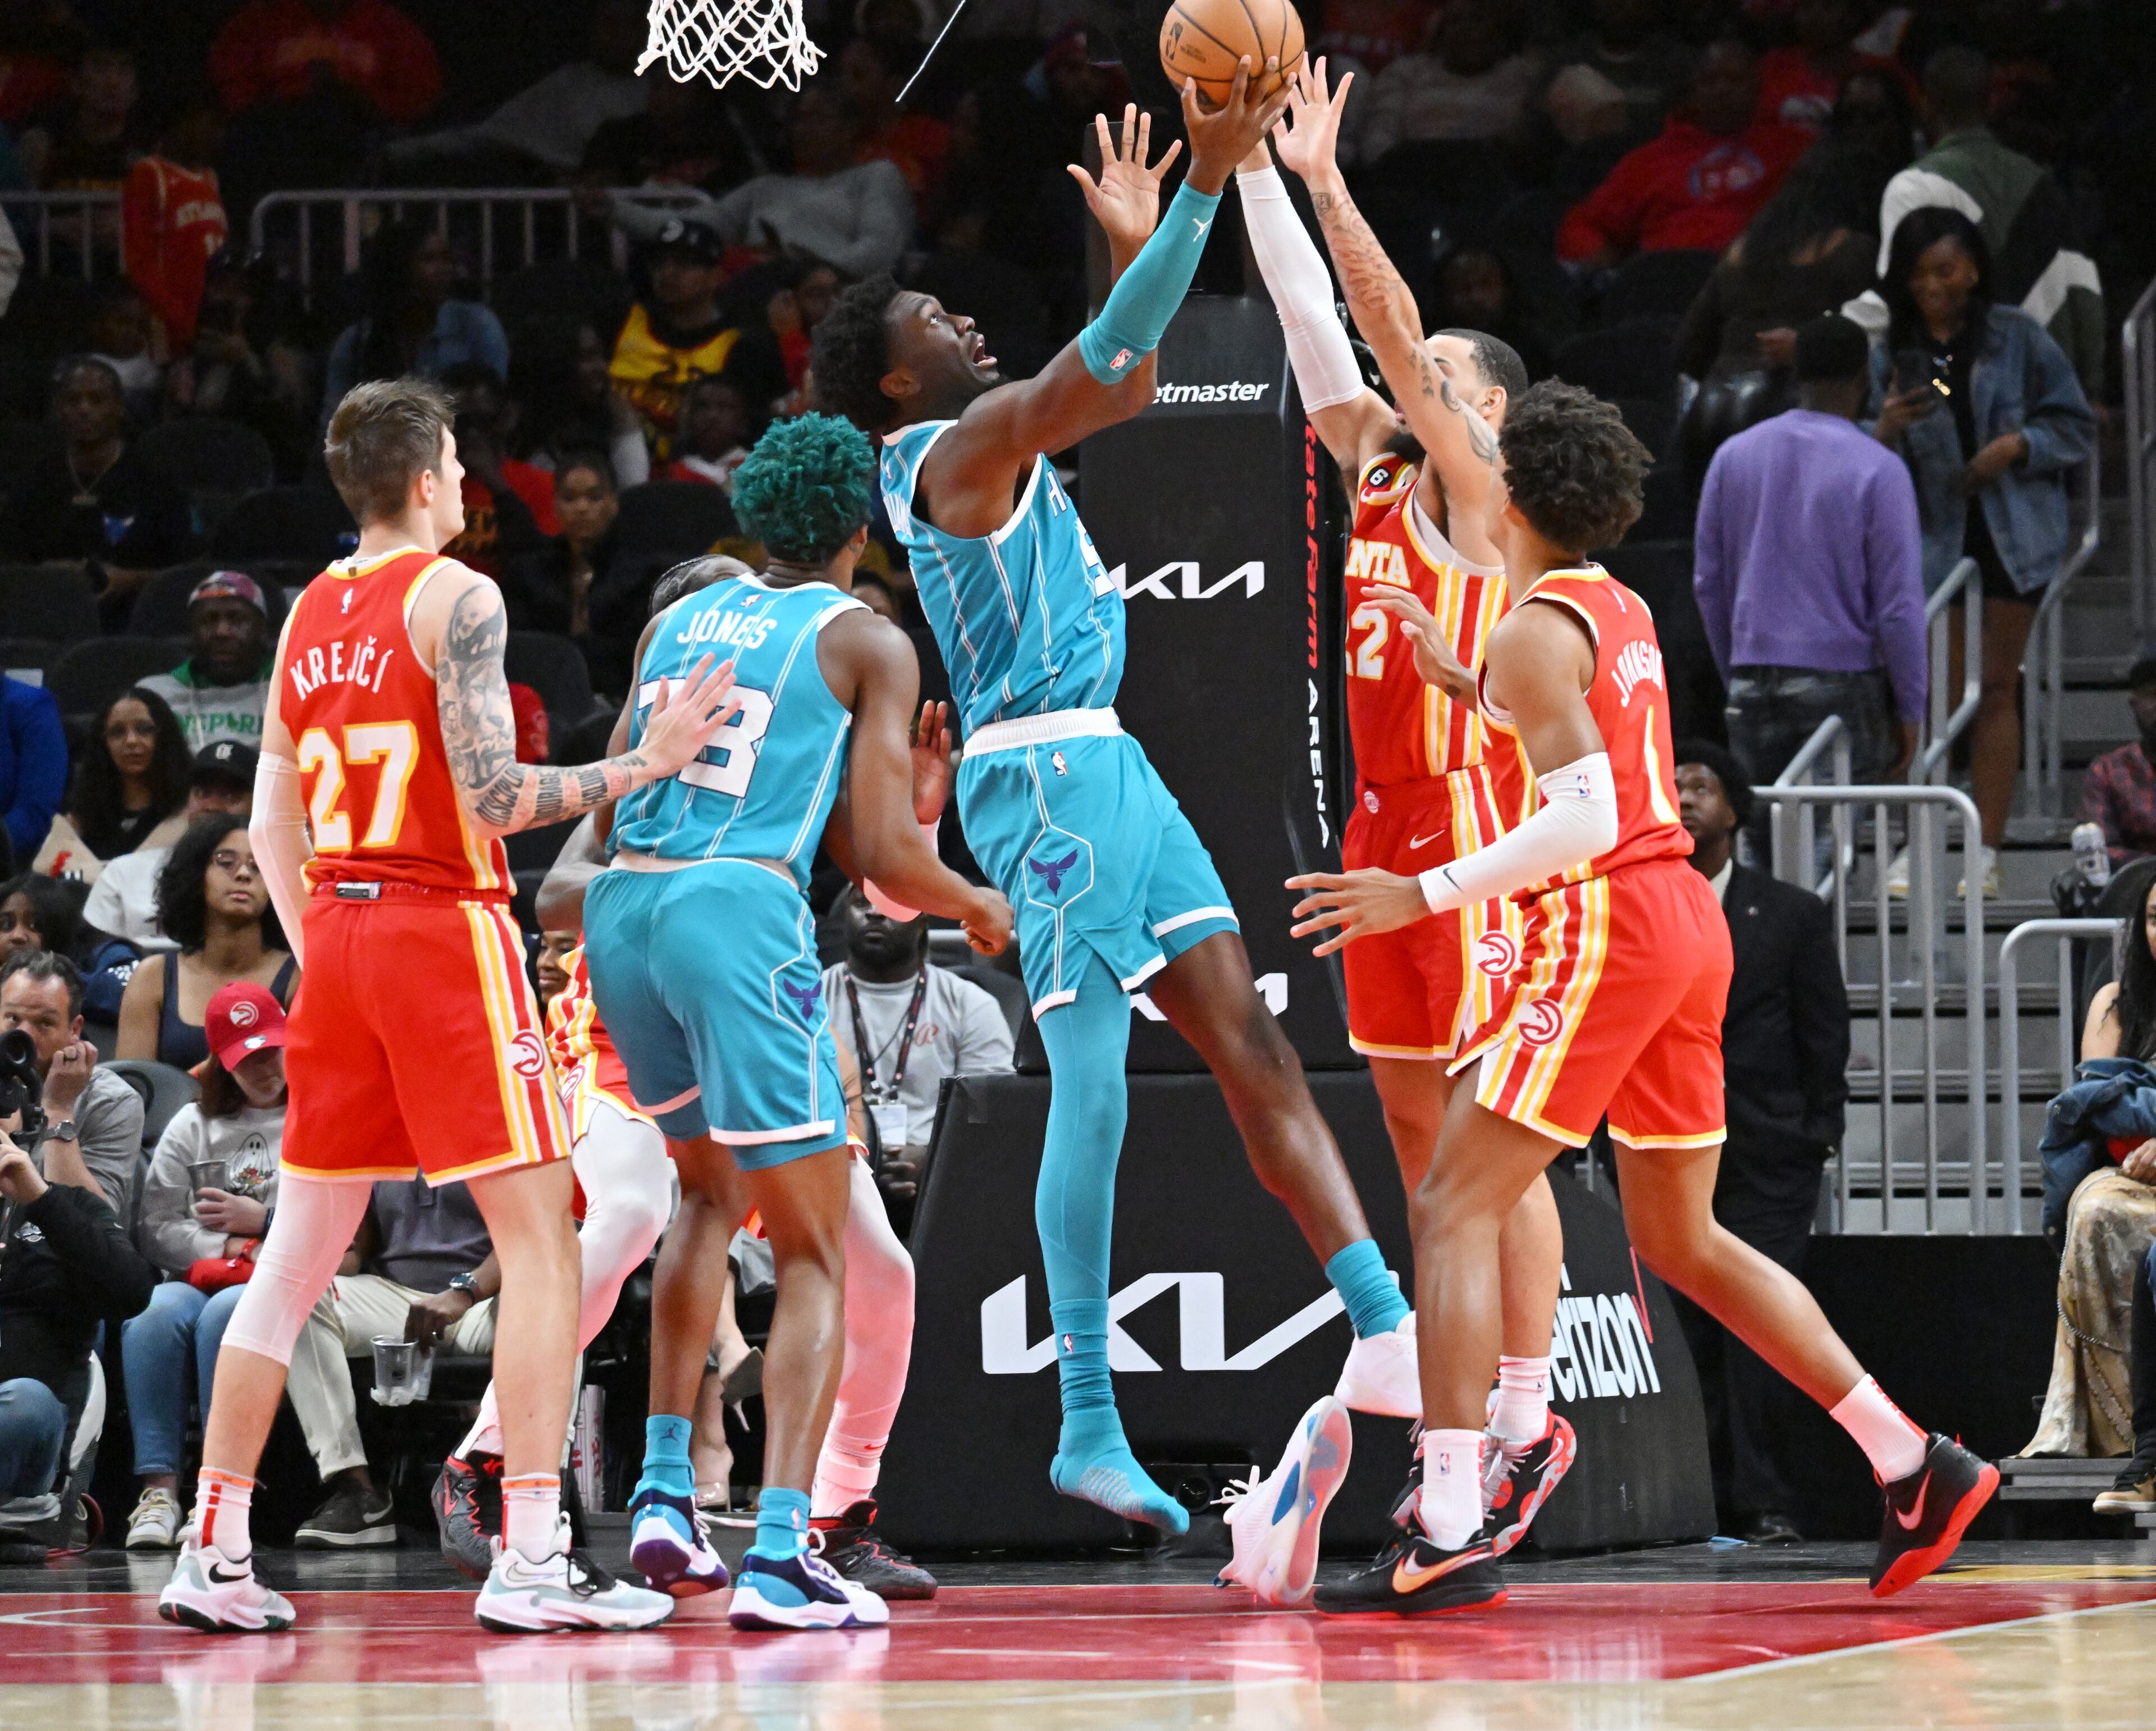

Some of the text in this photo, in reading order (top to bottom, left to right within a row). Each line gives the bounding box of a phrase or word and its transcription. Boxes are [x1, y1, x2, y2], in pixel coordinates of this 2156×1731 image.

[1304, 414, 1317, 532] tate
[1369, 468, 1390, 486] 6
[1108, 561, 1265, 600] KIA
[289, 634, 395, 701] KREJČÍ
[676, 609, 778, 650] JONES
[1345, 602, 1389, 681] 2
[296, 719, 421, 853] 27
[1308, 677, 1330, 849] ARENA
[1546, 1292, 1661, 1403] erizon
